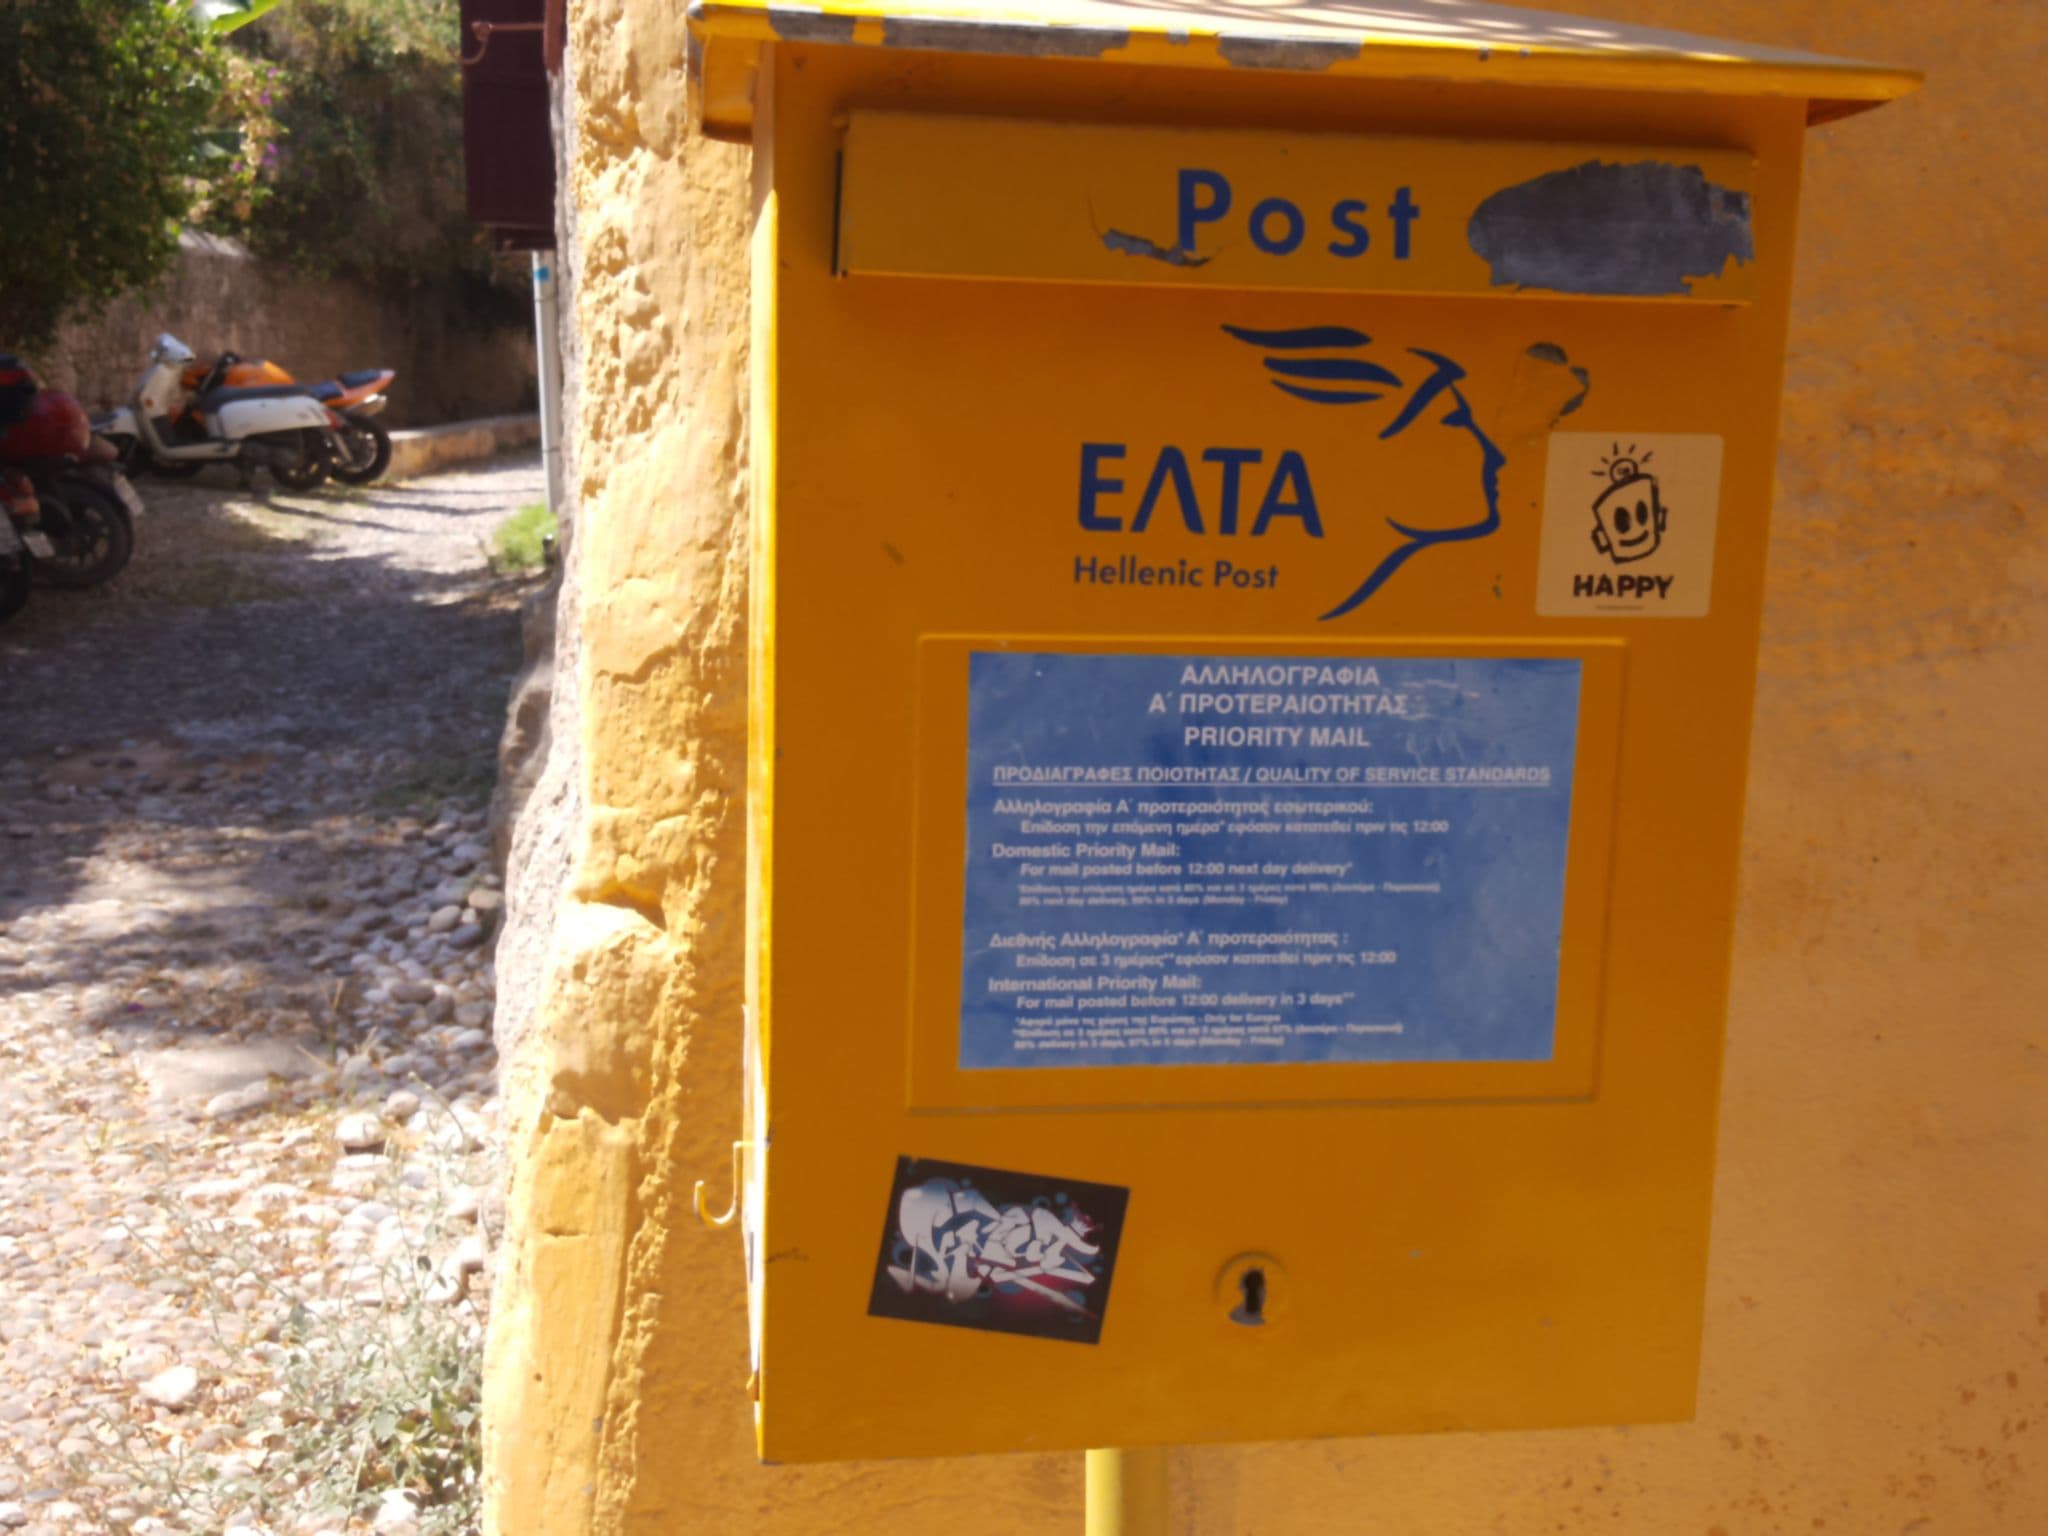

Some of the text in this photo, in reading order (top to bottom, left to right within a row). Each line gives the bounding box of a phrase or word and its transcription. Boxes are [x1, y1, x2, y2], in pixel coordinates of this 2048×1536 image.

[1177, 167, 1420, 260] Post
[1078, 442, 1325, 539] ΕΛΤΑ
[1073, 555, 1279, 589] Hellenic Post
[1572, 573, 1675, 599] HAPPY
[1180, 665, 1380, 686] ΑΛΛΗΛΟΓΡΑΦΙΑ
[1180, 693, 1409, 715] ΠΡΟΤΕΡΑΙΟΤΗΤΑΣ
[1184, 726, 1371, 748] PRIORITY MAIL
[993, 766, 1133, 782] ΠΡΟΔΙΑΓΡΑΦΕΣ
[1137, 767, 1241, 782] ΠΟΙΟΤΗΤΑΣ
[1256, 767, 1330, 783] QUALITY
[1335, 767, 1360, 782] OF
[1365, 767, 1441, 782] SERVICE
[1445, 767, 1551, 782] STANDARDS
[1413, 820, 1450, 833] 12:00
[991, 842, 1181, 860] Domestic Priority Mail:
[1020, 863, 1045, 877] For
[1049, 863, 1079, 876] mail
[1082, 863, 1132, 878] posted
[1136, 862, 1182, 875] before
[1187, 862, 1226, 875] 12:00
[1228, 863, 1259, 875] next
[1262, 862, 1289, 877] day
[989, 931, 1056, 950] Διεθνής
[1360, 951, 1397, 964] 12:00
[988, 974, 1202, 992] International Priority Mail:
[1016, 996, 1040, 1009] For
[1045, 996, 1074, 1008] mail
[1078, 995, 1127, 1010] posted
[1131, 995, 1176, 1007] before
[1181, 994, 1218, 1006] 12:00
[1221, 993, 1276, 1008] delivery
[1281, 993, 1293, 1005] in
